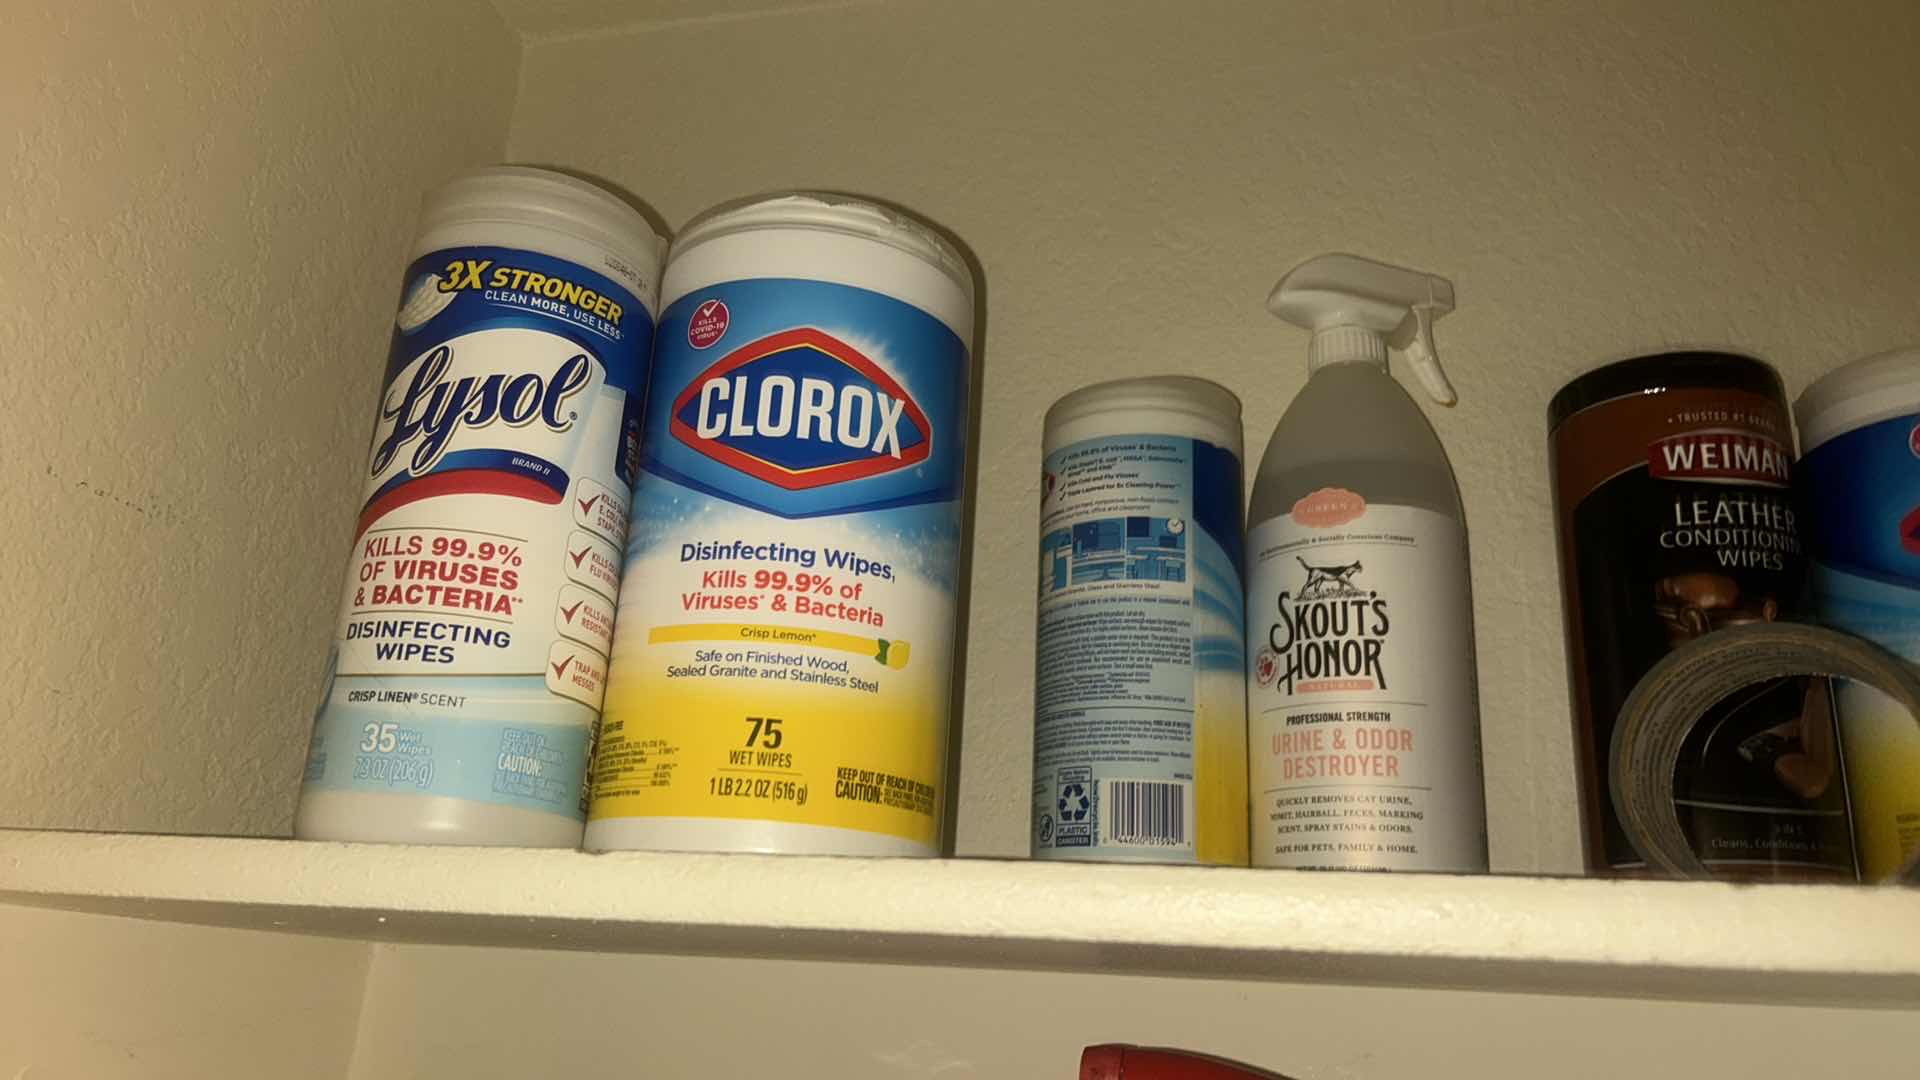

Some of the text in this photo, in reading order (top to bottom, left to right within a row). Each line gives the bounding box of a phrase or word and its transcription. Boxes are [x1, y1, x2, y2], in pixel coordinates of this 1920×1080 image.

[440, 260, 492, 291] 3X
[490, 267, 623, 325] STRONGER
[484, 290, 527, 305] CLEAN
[530, 297, 570, 318] MORE,
[574, 309, 596, 326] USE
[697, 375, 905, 460] CLOROX
[1678, 412, 1728, 424] TRUSTED
[512, 457, 542, 472] BRAND
[1662, 441, 1788, 481] WEIMAN
[1675, 500, 1796, 536] LEATHER
[364, 536, 522, 567] KILLS 99.9%
[680, 540, 816, 568] Disinfecting
[1660, 529, 1800, 555] CONDITIONIN
[591, 552, 608, 568] KILLS
[1717, 549, 1783, 570] WIPES
[359, 560, 519, 590] OF VIRUSES
[702, 569, 863, 601] Kills 99.9% of
[354, 587, 365, 606] &
[583, 605, 600, 620] KILLS
[771, 595, 787, 611] &
[795, 595, 884, 627] Bacteria
[1270, 591, 1390, 654] SKOUT'S
[346, 621, 511, 648] DISINFECTING
[740, 628, 769, 640] Crisp
[376, 642, 454, 664] WIPES
[695, 649, 850, 674] Safe on Finished Wood,
[575, 661, 589, 675] TRAP
[667, 665, 879, 693] Sealed Granite and Stainless Steel
[1277, 639, 1387, 696] HONOR
[348, 690, 377, 703] CRISP
[419, 693, 467, 708] SCENT
[1286, 711, 1391, 726] PROFESSIONAL STRENGTH
[360, 721, 400, 753] 35
[399, 730, 423, 743] Wet
[745, 717, 783, 749] 75
[1272, 728, 1414, 755] URINE & ODOR
[399, 743, 432, 756] Wipes
[729, 750, 792, 768] WET WIPES
[837, 767, 858, 780] KEEP
[859, 769, 875, 783] OUT
[876, 772, 886, 785] OF
[886, 775, 907, 789] REACH
[1283, 754, 1399, 781] DESTROYER
[709, 778, 808, 805] 1 LB 2.2 OZ (516 g)
[1276, 796, 1308, 808] QUICKLY
[1311, 795, 1354, 804] REMOVES
[1378, 810, 1424, 820] MARKING
[1304, 823, 1331, 833] SPRAY
[1338, 842, 1375, 852] FAMILY
